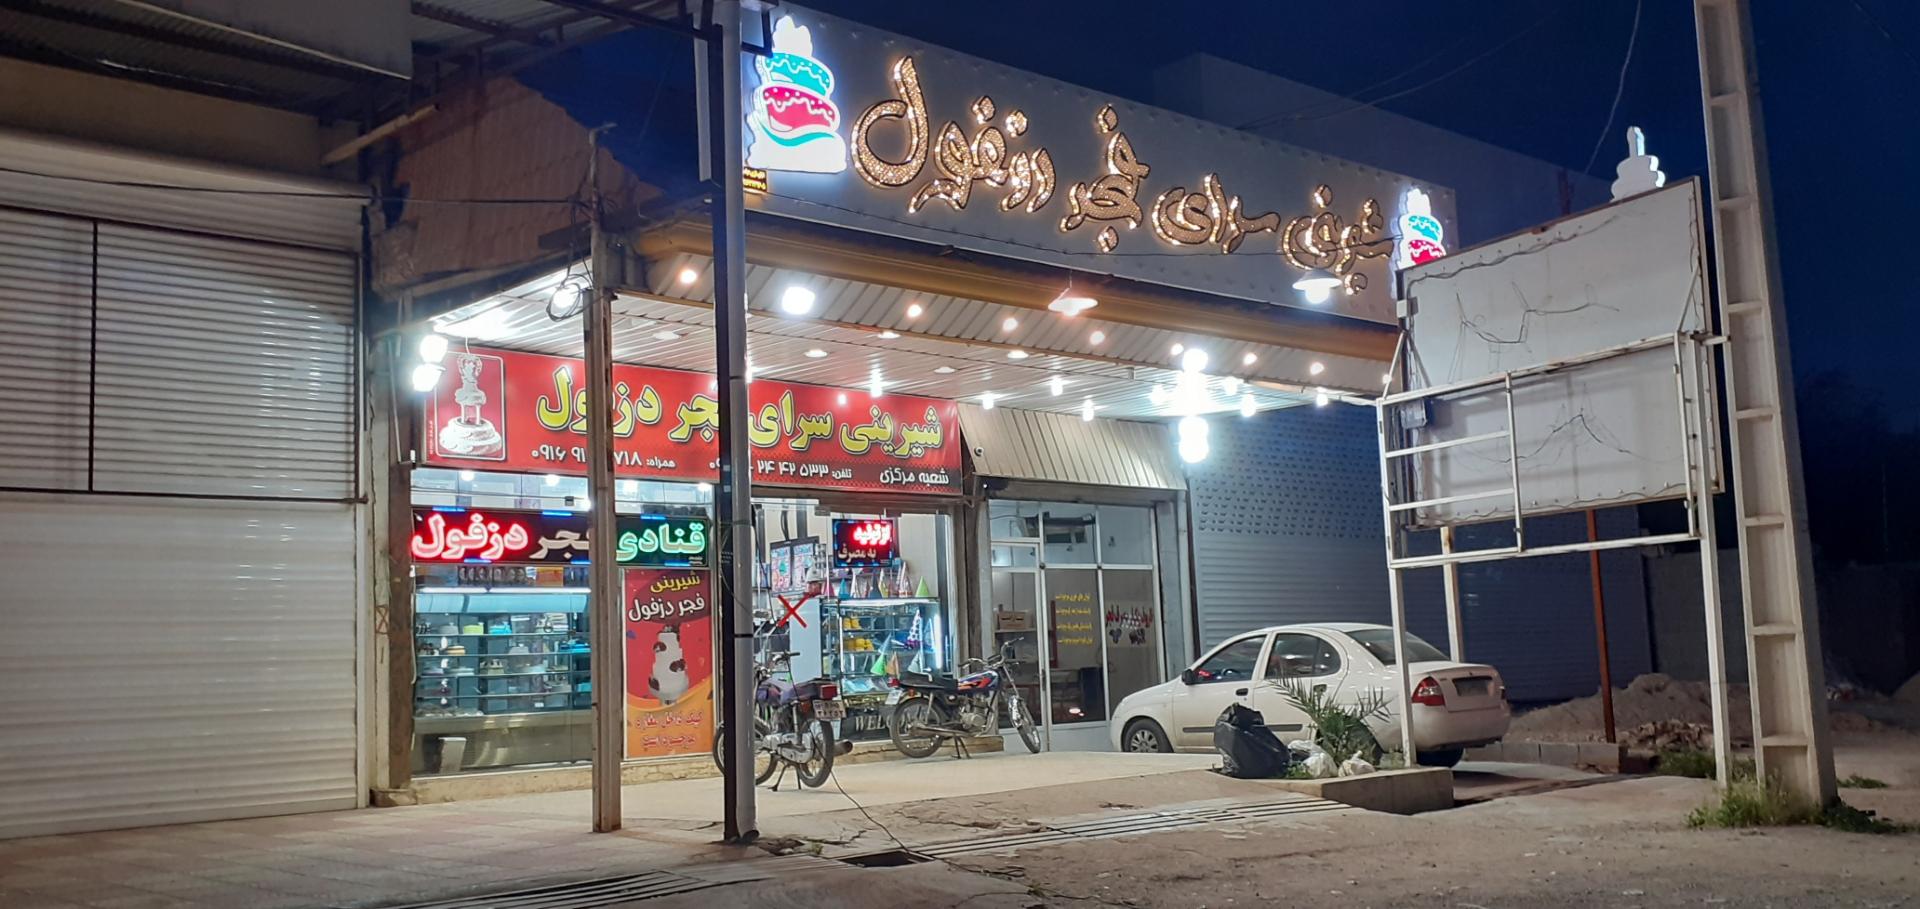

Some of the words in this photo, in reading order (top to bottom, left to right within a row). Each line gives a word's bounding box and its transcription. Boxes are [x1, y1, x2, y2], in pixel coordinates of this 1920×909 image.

[851, 55, 1056, 214] دزفول
[1059, 103, 1151, 253] فجر
[1152, 173, 1281, 255] سرای
[667, 393, 719, 443] جر
[748, 389, 833, 452] سرای
[840, 404, 943, 460] شیرینی
[879, 466, 915, 485] مرکزی
[918, 467, 949, 486] شعبه
[411, 512, 529, 561] دزفول
[529, 529, 590, 560] جر
[616, 522, 706, 562] قنادی
[650, 569, 701, 593] شیرینی
[628, 596, 675, 621] دزفول
[678, 592, 705, 617] فجر
